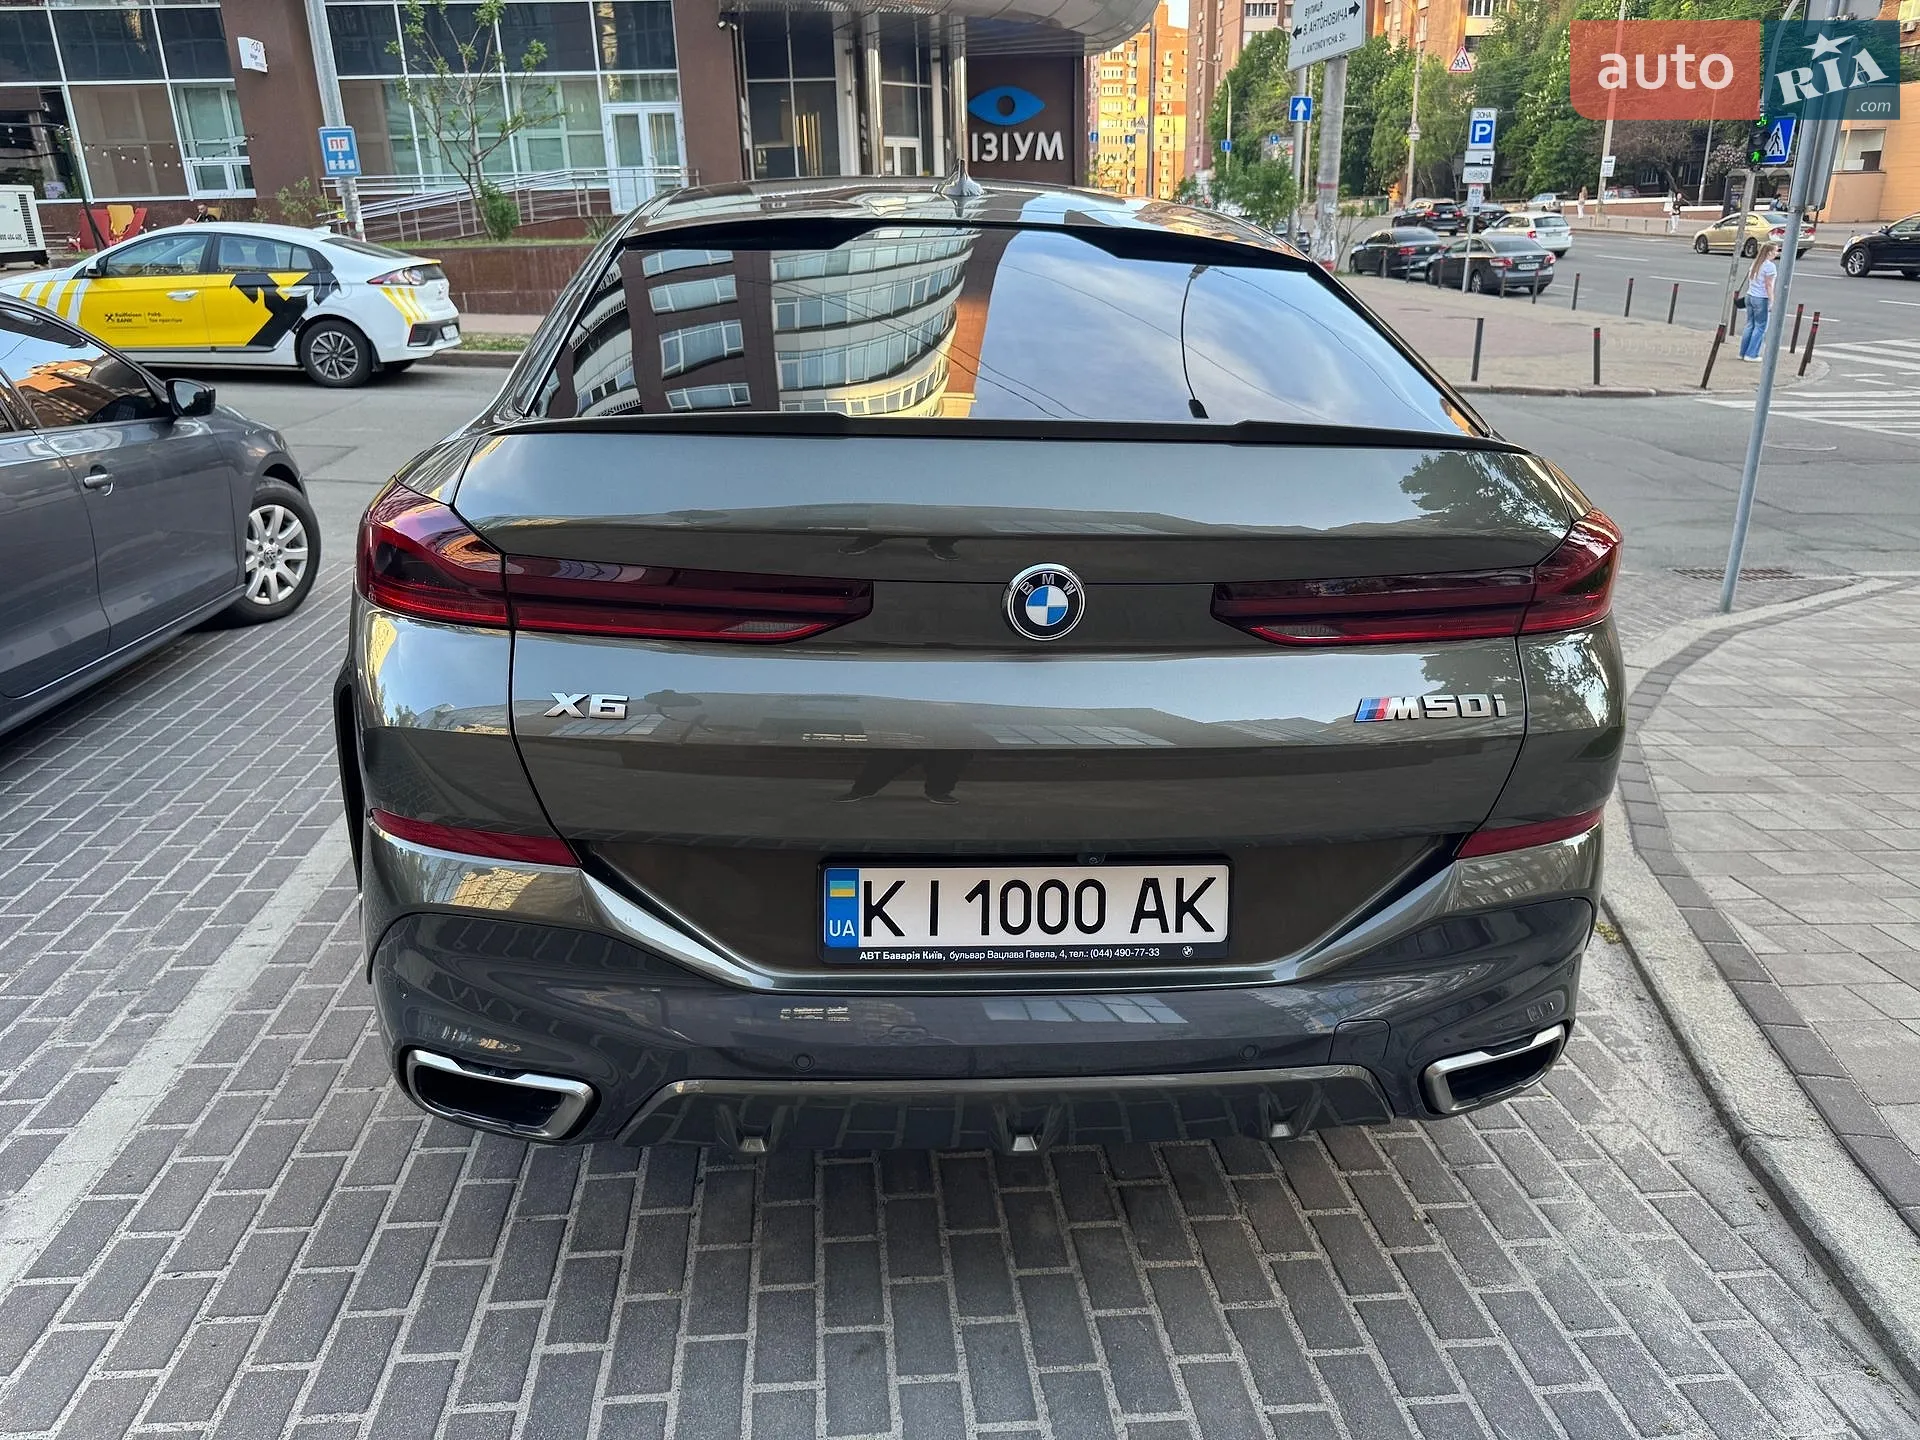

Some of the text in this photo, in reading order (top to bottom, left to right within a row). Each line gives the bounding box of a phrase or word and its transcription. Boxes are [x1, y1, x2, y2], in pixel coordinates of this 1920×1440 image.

[971, 131, 1065, 161] ІЗІУМ
[1020, 573, 1077, 596] BMW
[543, 692, 630, 720] X6
[964, 878, 1107, 937] 1000
[1129, 876, 1217, 935] AK
[829, 919, 856, 937] UA
[859, 951, 881, 960] АВТ
[883, 951, 920, 962] Баварія
[922, 951, 946, 962] Київ,
[949, 950, 985, 962] бульвар
[987, 950, 1024, 961] Вацлава
[1025, 949, 1058, 960] Гавела,
[1059, 949, 1068, 960] 4,
[1090, 948, 1113, 960] (044)
[1114, 947, 1160, 958] 490-77-33
